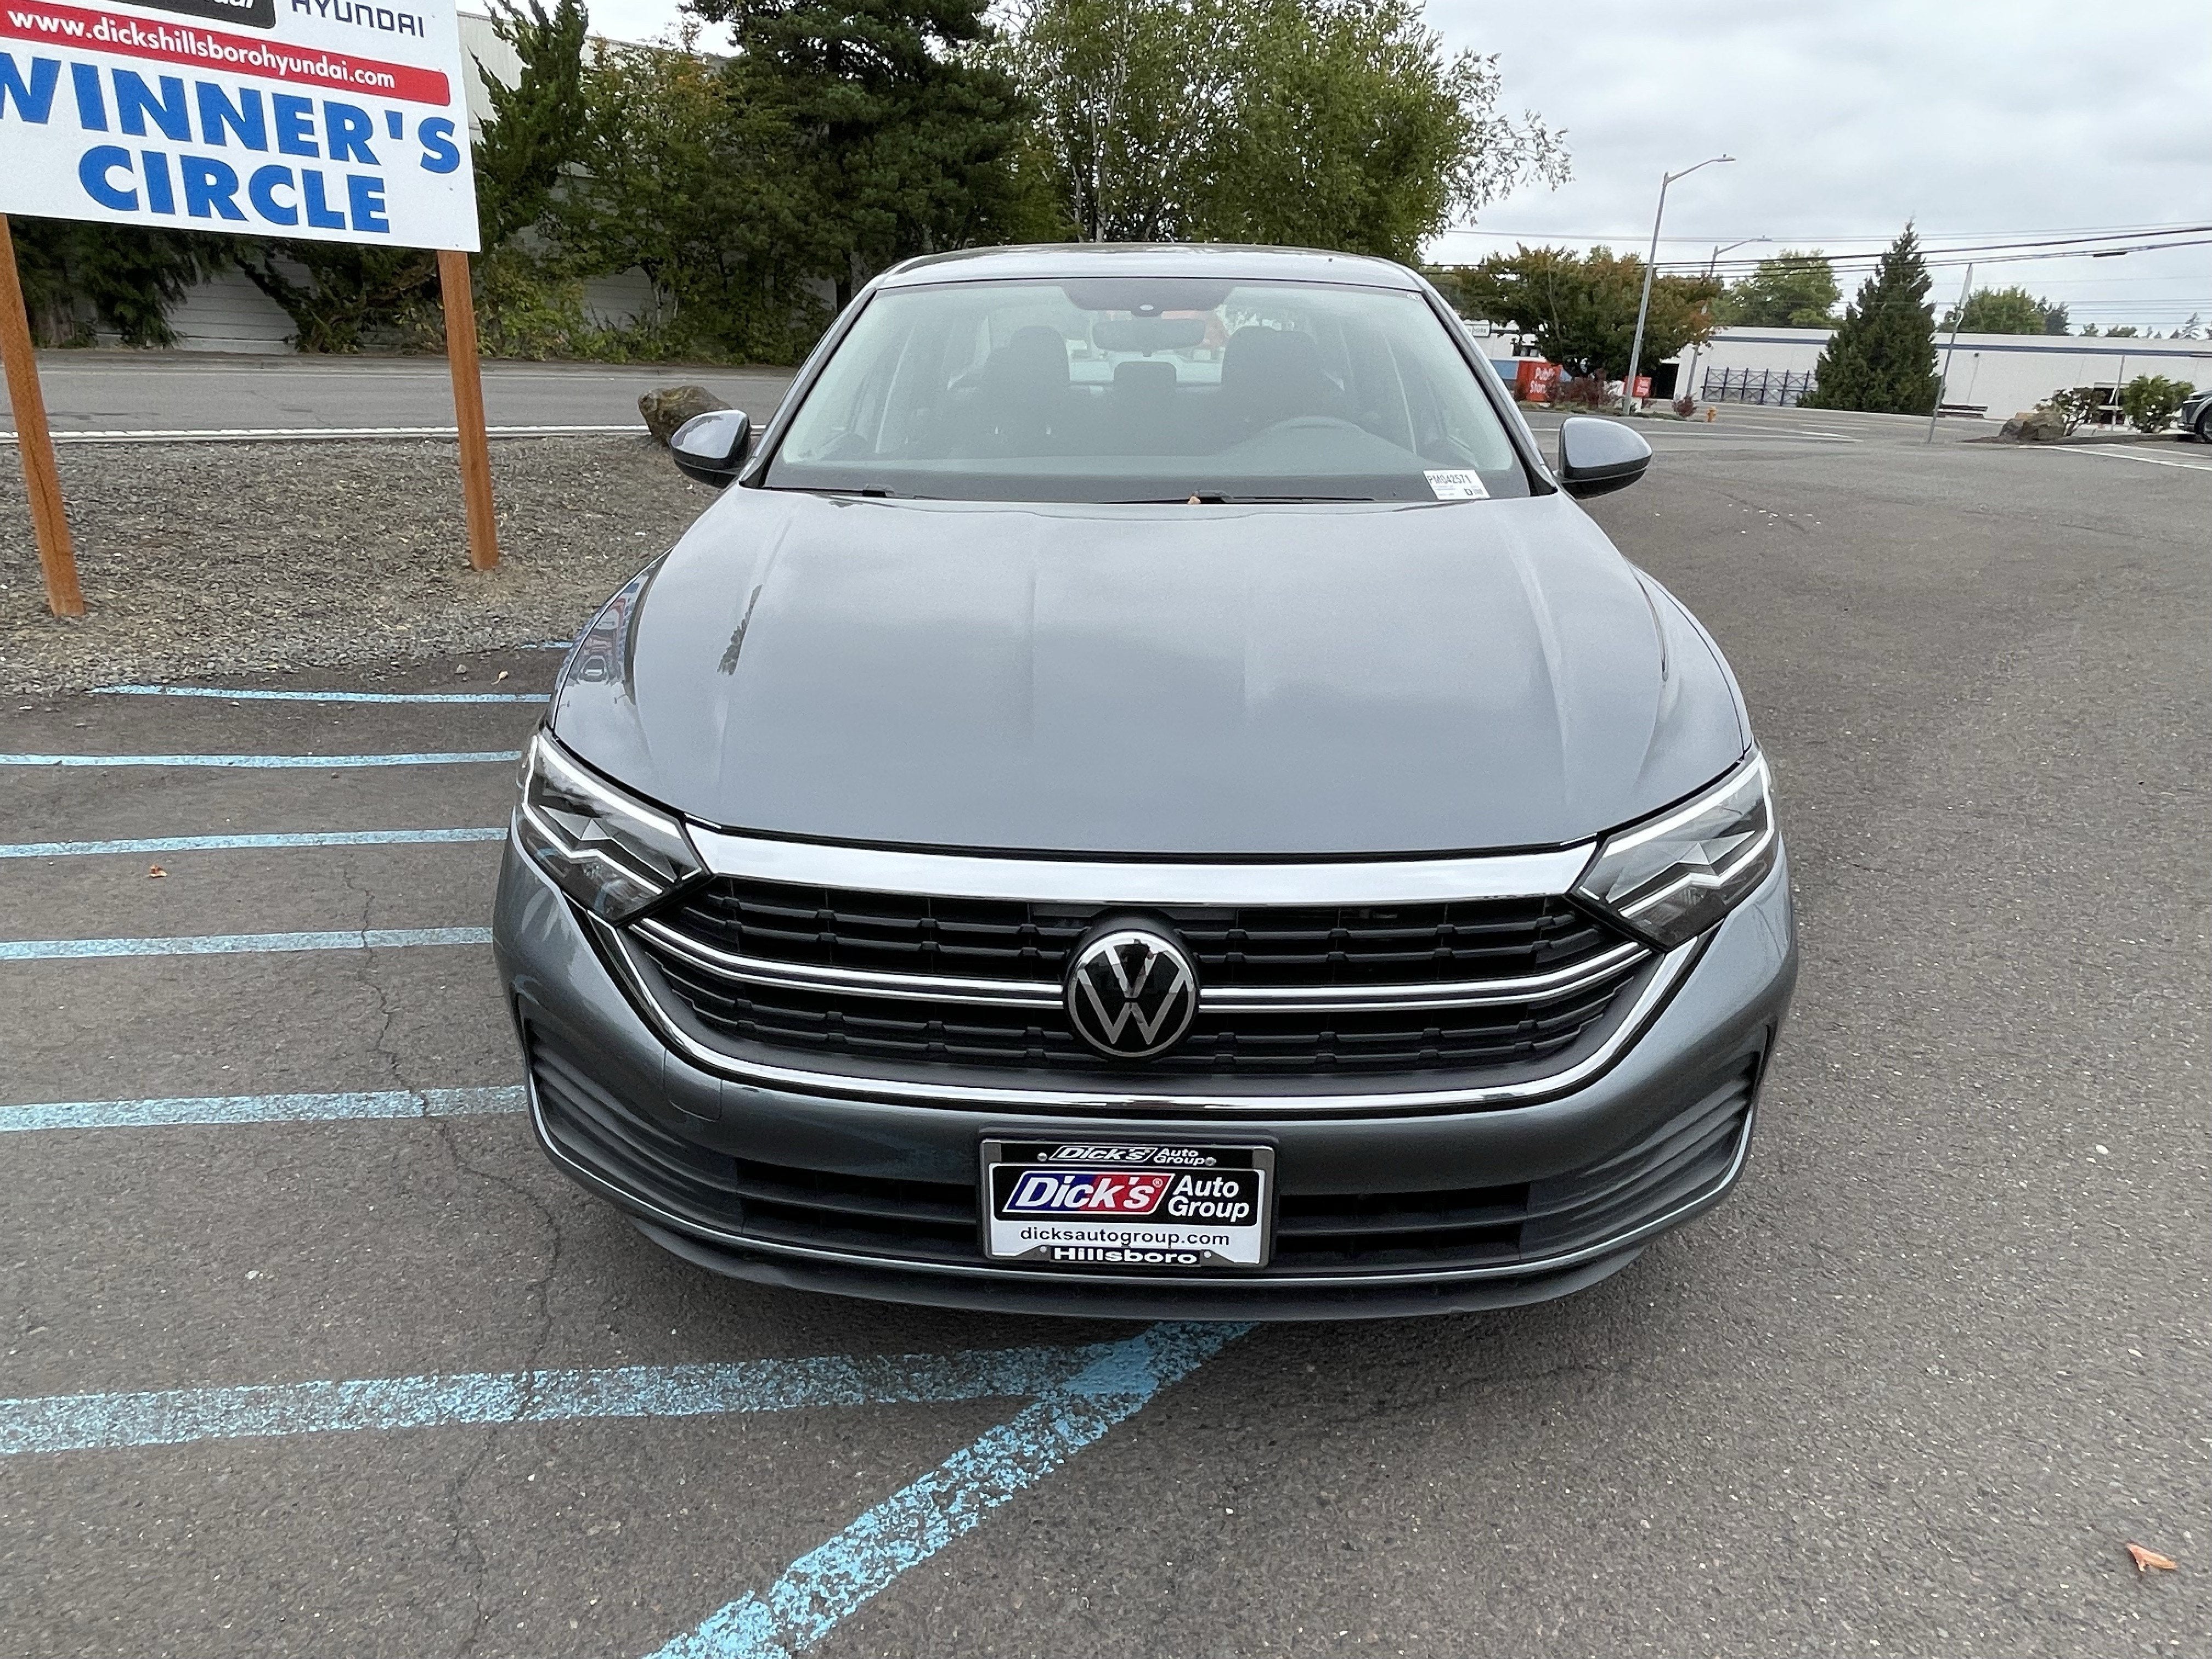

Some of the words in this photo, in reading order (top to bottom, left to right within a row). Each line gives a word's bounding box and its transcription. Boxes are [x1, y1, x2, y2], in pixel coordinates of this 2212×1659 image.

[292, 0, 425, 37] HYUNDAI
[8, 10, 396, 89] www.dickshillsborohyundai.com
[0, 53, 461, 174] WINNER'S
[78, 145, 390, 234] CIRCLE
[1077, 943, 1187, 1045] VW
[1153, 1156, 1205, 1166] Group
[1158, 1148, 1199, 1157] Auto
[1173, 1175, 1239, 1198] Auto
[1168, 1197, 1250, 1222] Group
[1020, 1227, 1230, 1245] dicksautogroup.com
[1054, 1248, 1198, 1264] Hillsboro
